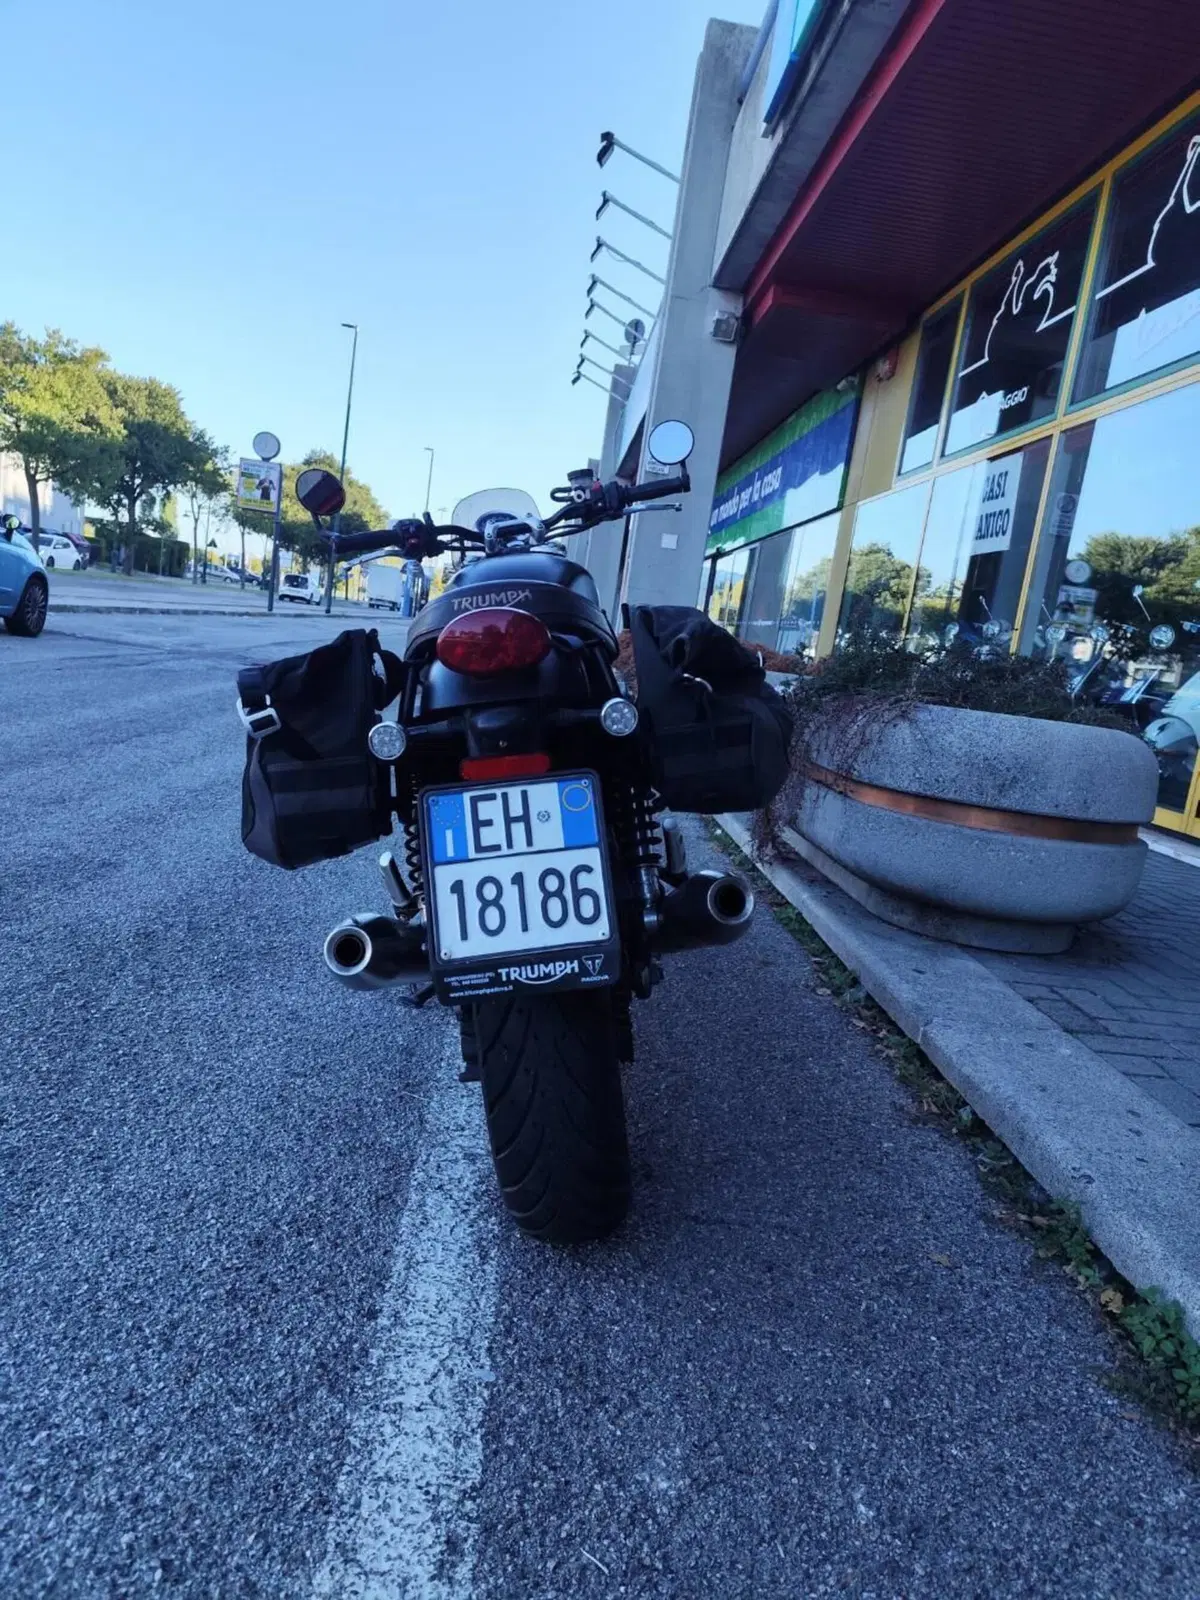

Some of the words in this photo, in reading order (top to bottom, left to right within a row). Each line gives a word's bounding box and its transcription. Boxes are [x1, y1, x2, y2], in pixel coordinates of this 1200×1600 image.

[761, 465, 783, 498] casa
[452, 588, 532, 611] TRIUMPH
[469, 789, 534, 854] EH
[450, 864, 601, 941] 18186
[497, 960, 579, 984] TRIUMPH
